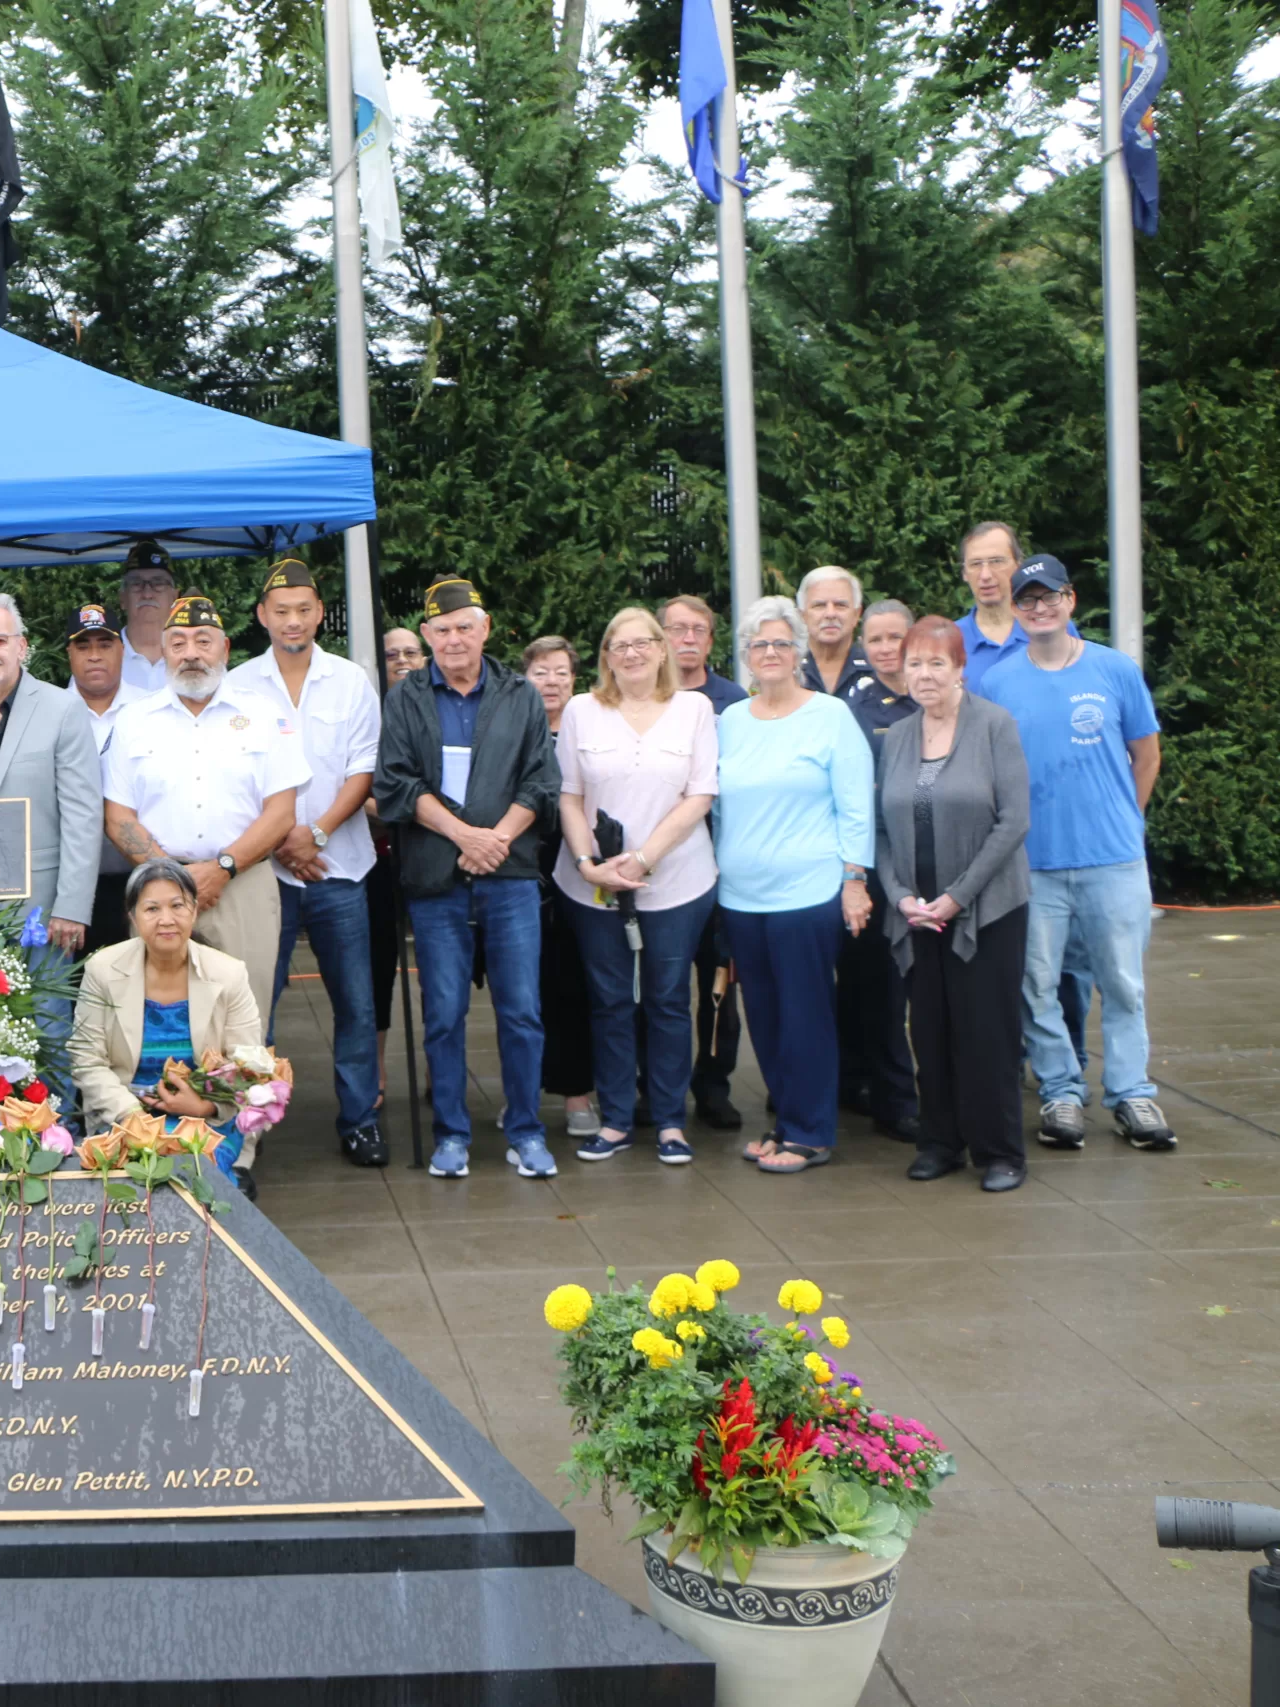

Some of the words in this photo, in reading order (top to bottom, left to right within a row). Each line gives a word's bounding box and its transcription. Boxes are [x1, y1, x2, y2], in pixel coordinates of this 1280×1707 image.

[1022, 562, 1044, 576] VOI
[1069, 692, 1106, 704] ISLANDIA
[43, 1202, 96, 1216] were
[21, 1230, 76, 1248] Polic
[100, 1228, 191, 1246] Officers
[12, 1262, 65, 1280] their
[140, 1261, 166, 1277] at
[73, 1361, 188, 1382] Mahoney,
[202, 1354, 292, 1376] F.D.N.Y.
[6, 1472, 62, 1492] Glen
[74, 1470, 151, 1492] Pettit,
[163, 1466, 260, 1488] N.Y.P.D.
